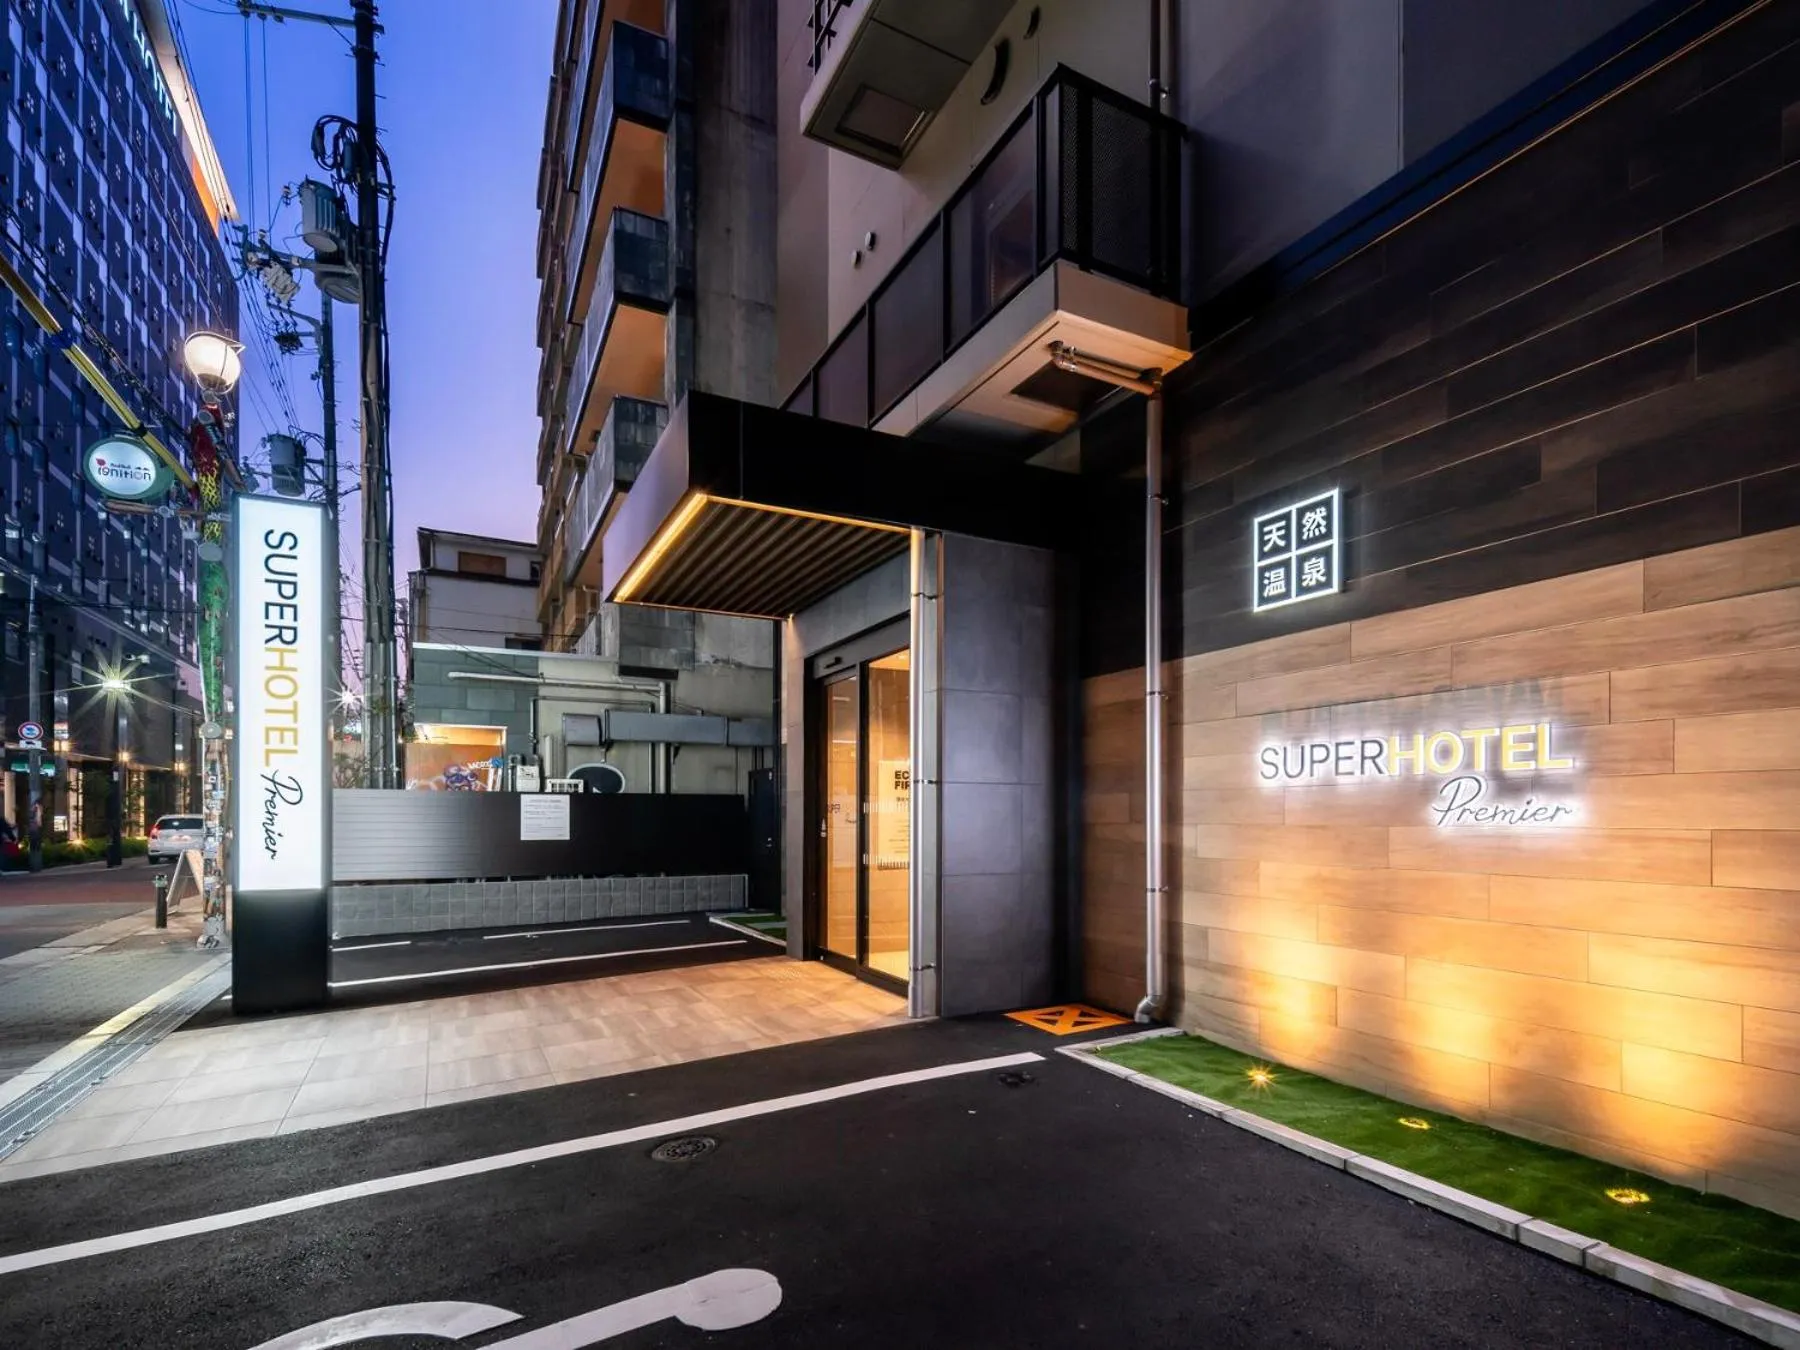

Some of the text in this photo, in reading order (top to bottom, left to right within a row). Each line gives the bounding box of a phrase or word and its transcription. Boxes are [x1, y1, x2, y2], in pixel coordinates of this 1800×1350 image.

[1263, 506, 1327, 553] 天然
[1263, 557, 1327, 598] 温泉
[264, 529, 299, 767] SUPERHOTEL
[1259, 721, 1574, 780] SUPERHOTEL
[260, 769, 303, 860] Premier
[1432, 775, 1573, 826] Premier
